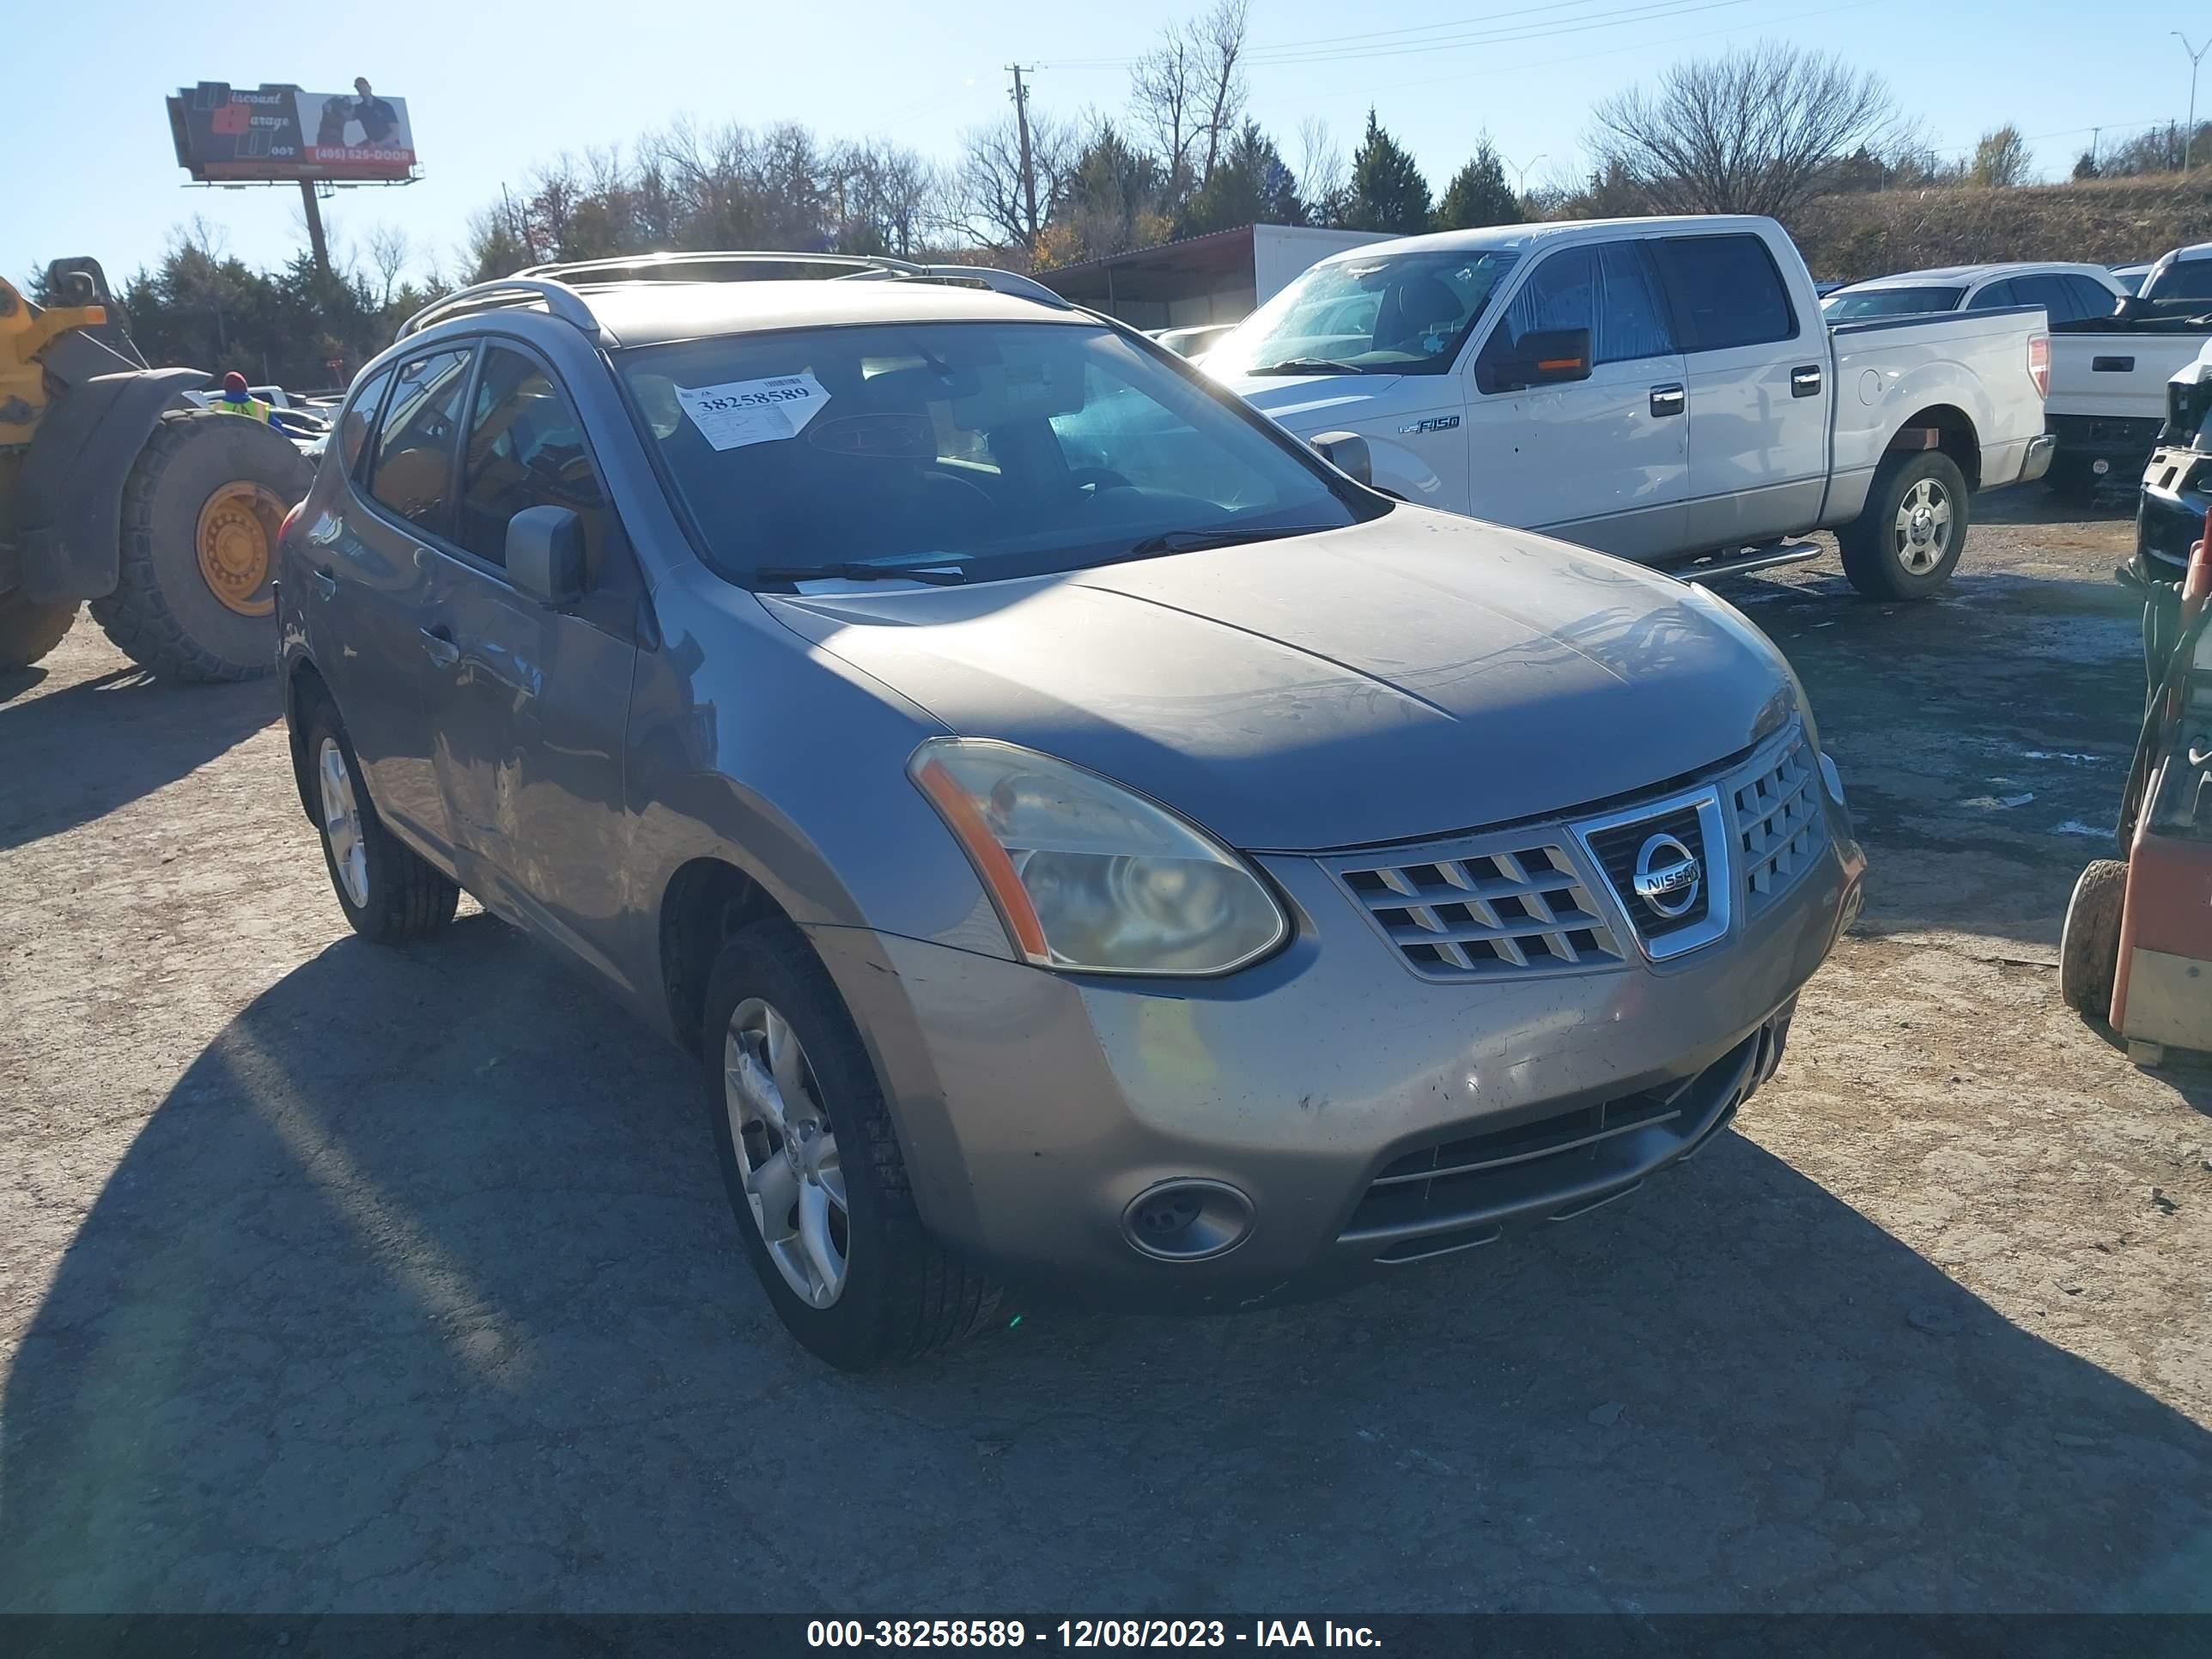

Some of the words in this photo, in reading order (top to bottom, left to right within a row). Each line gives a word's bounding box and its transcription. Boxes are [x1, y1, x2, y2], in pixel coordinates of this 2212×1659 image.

[315, 149, 345, 161] (405)
[697, 387, 810, 413] 38258589
[1646, 860, 1698, 890] NISSAN
